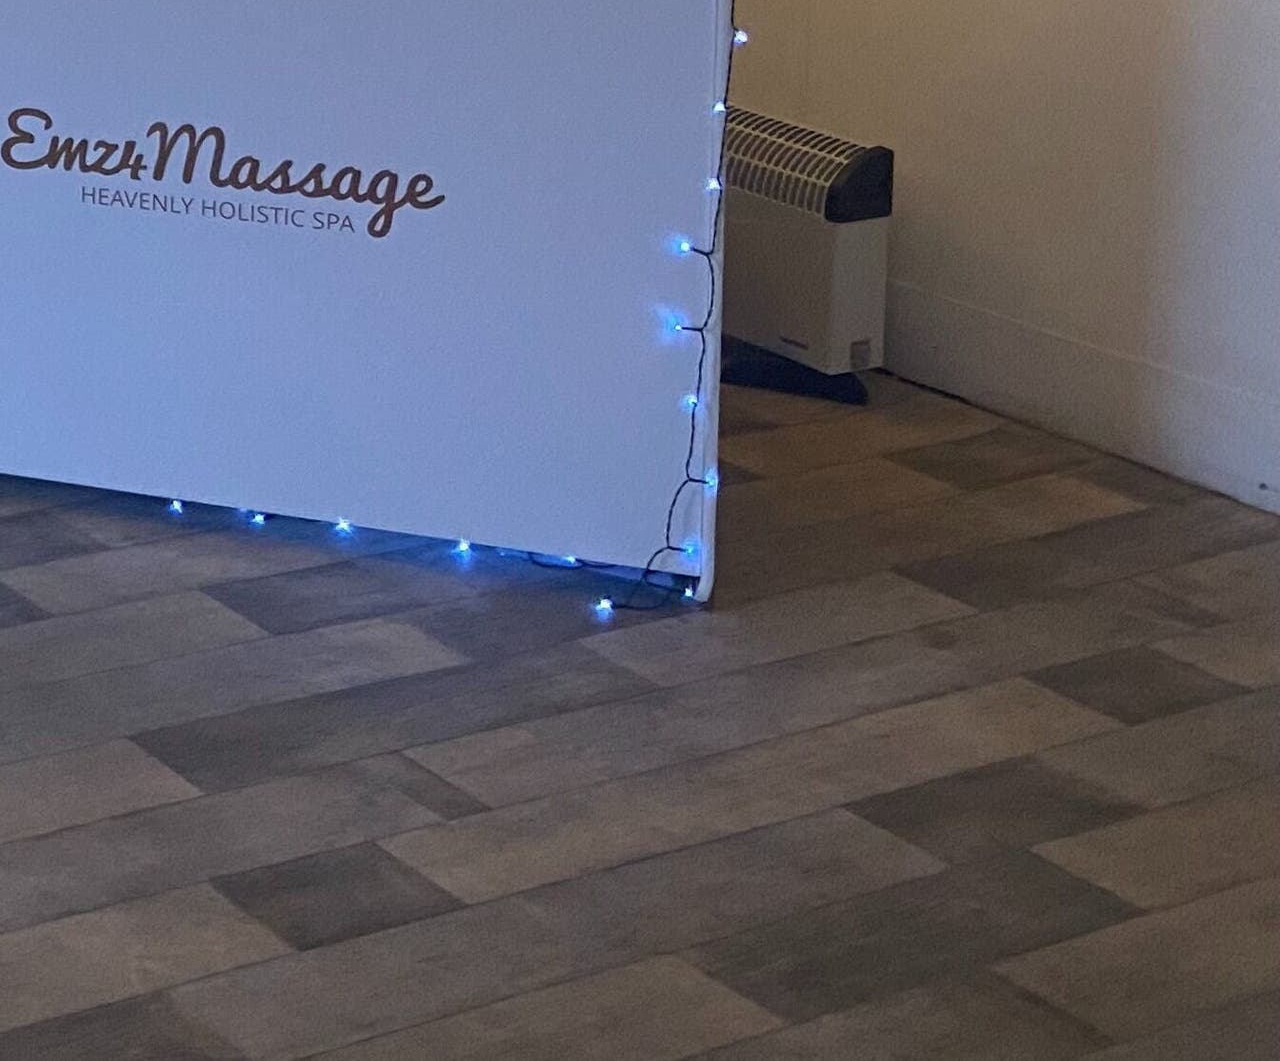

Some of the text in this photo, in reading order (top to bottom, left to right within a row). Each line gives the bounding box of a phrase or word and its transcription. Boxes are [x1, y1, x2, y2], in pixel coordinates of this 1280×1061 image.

[0, 106, 447, 239] Emz4Massage
[81, 185, 357, 233] HEAVENLY HOLISTIC SPA
